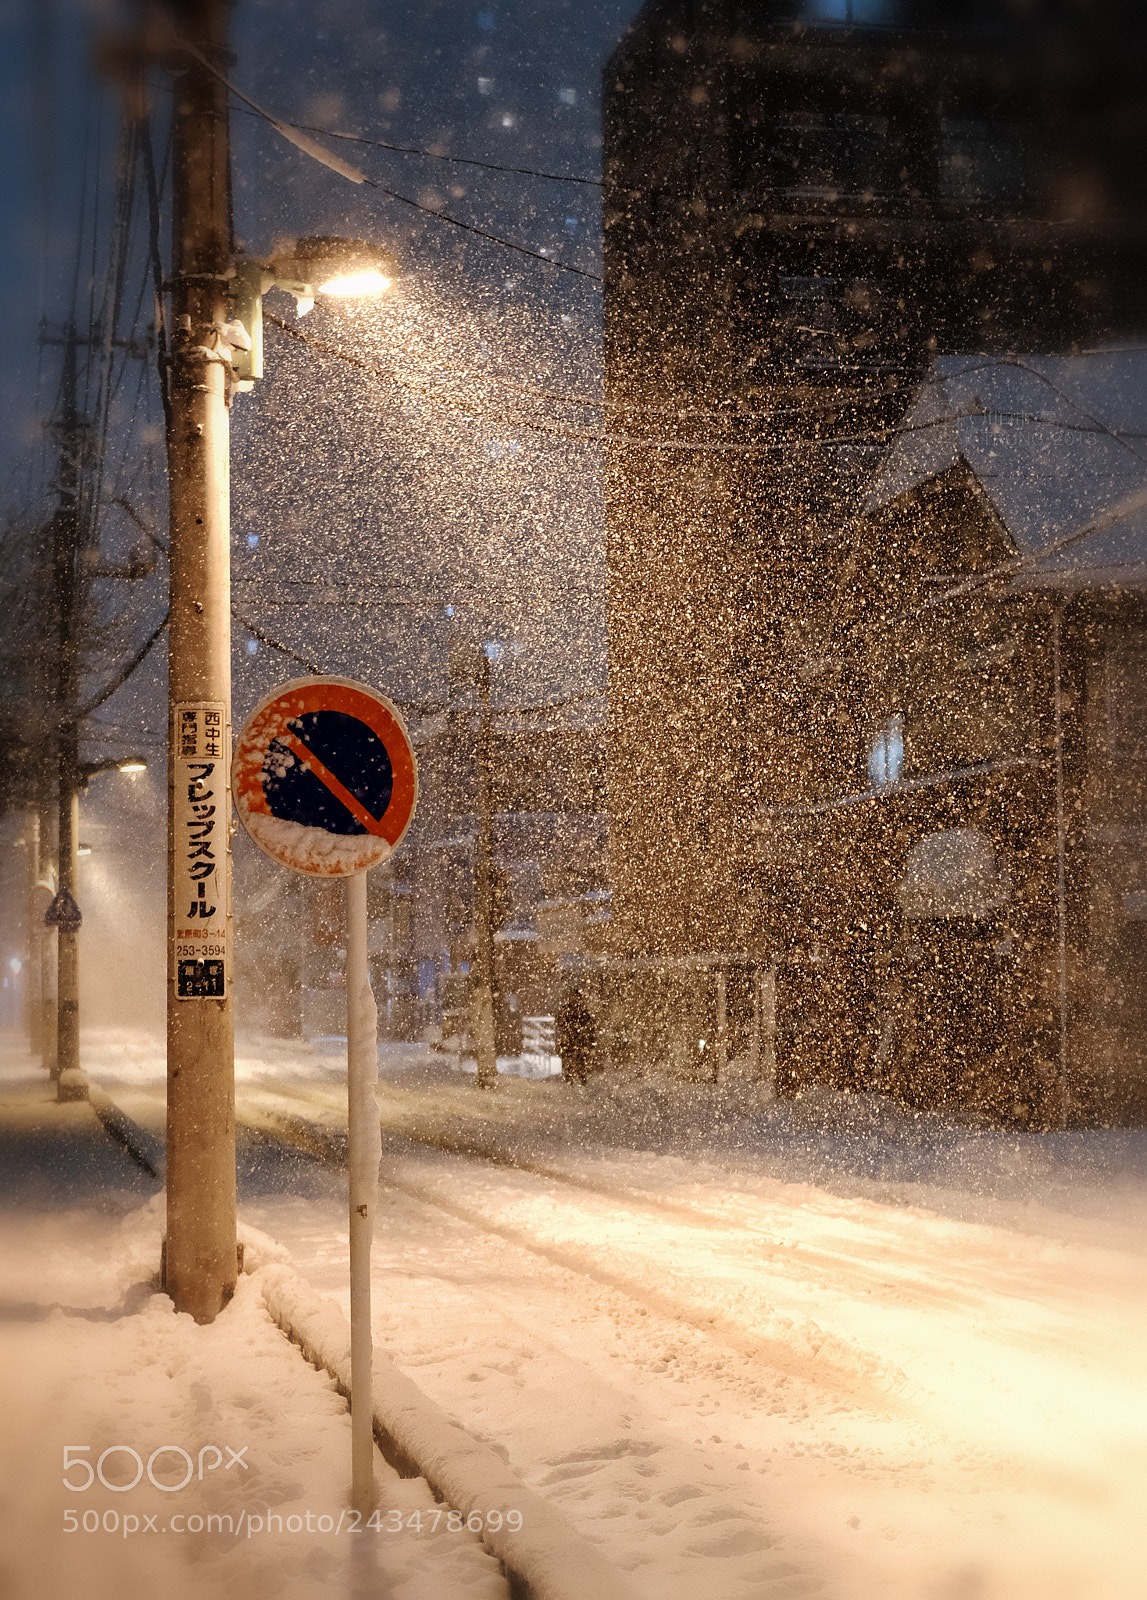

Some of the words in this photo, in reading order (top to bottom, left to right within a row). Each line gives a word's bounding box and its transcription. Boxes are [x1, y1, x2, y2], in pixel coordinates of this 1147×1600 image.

[205, 711, 220, 757] 西中生
[187, 763, 216, 918] プレップスクール
[176, 945, 226, 957] 253-3594
